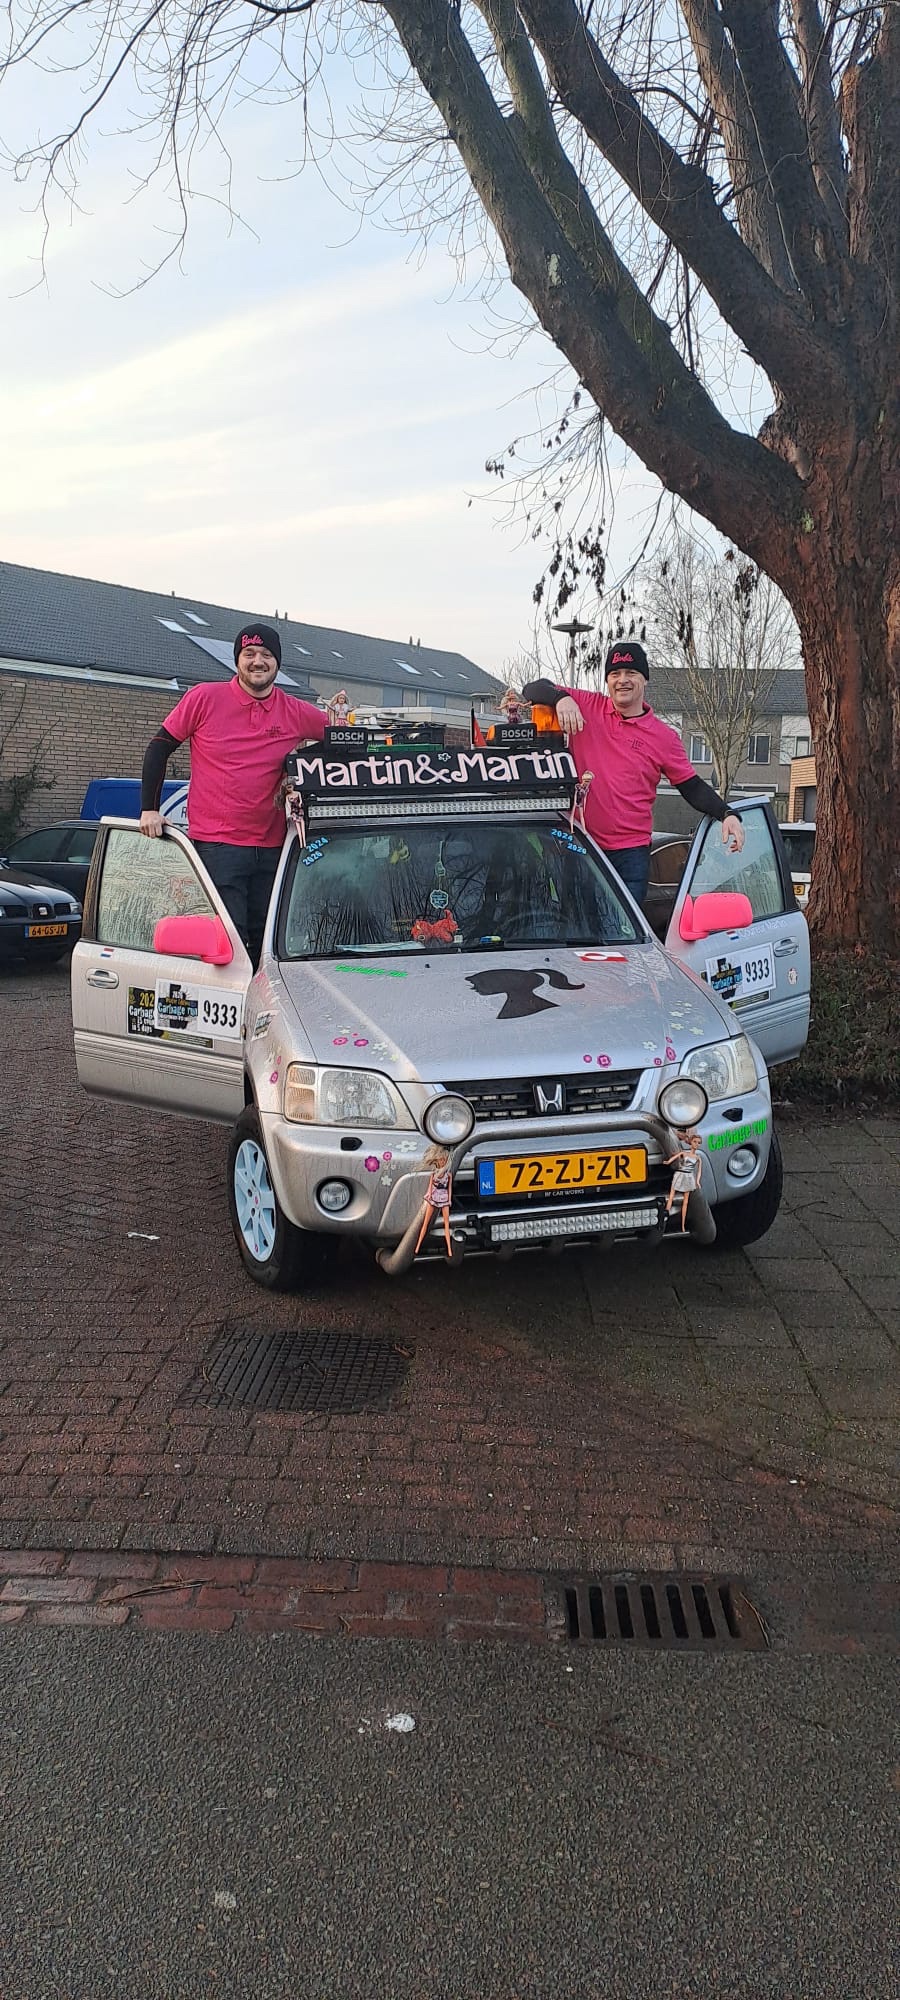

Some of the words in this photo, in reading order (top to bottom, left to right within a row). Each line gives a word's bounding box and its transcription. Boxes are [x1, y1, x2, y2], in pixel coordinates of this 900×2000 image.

[330, 732, 364, 741] BOSCH
[502, 729, 534, 738] BOSCH
[306, 837, 328, 852] 2024
[745, 958, 770, 982] 9333
[140, 992, 155, 1007] 202
[129, 1005, 155, 1019] Carbag
[203, 1000, 237, 1028] 9333
[481, 1182, 494, 1190] NL
[509, 1154, 631, 1189] 72-ZJ-ZR
